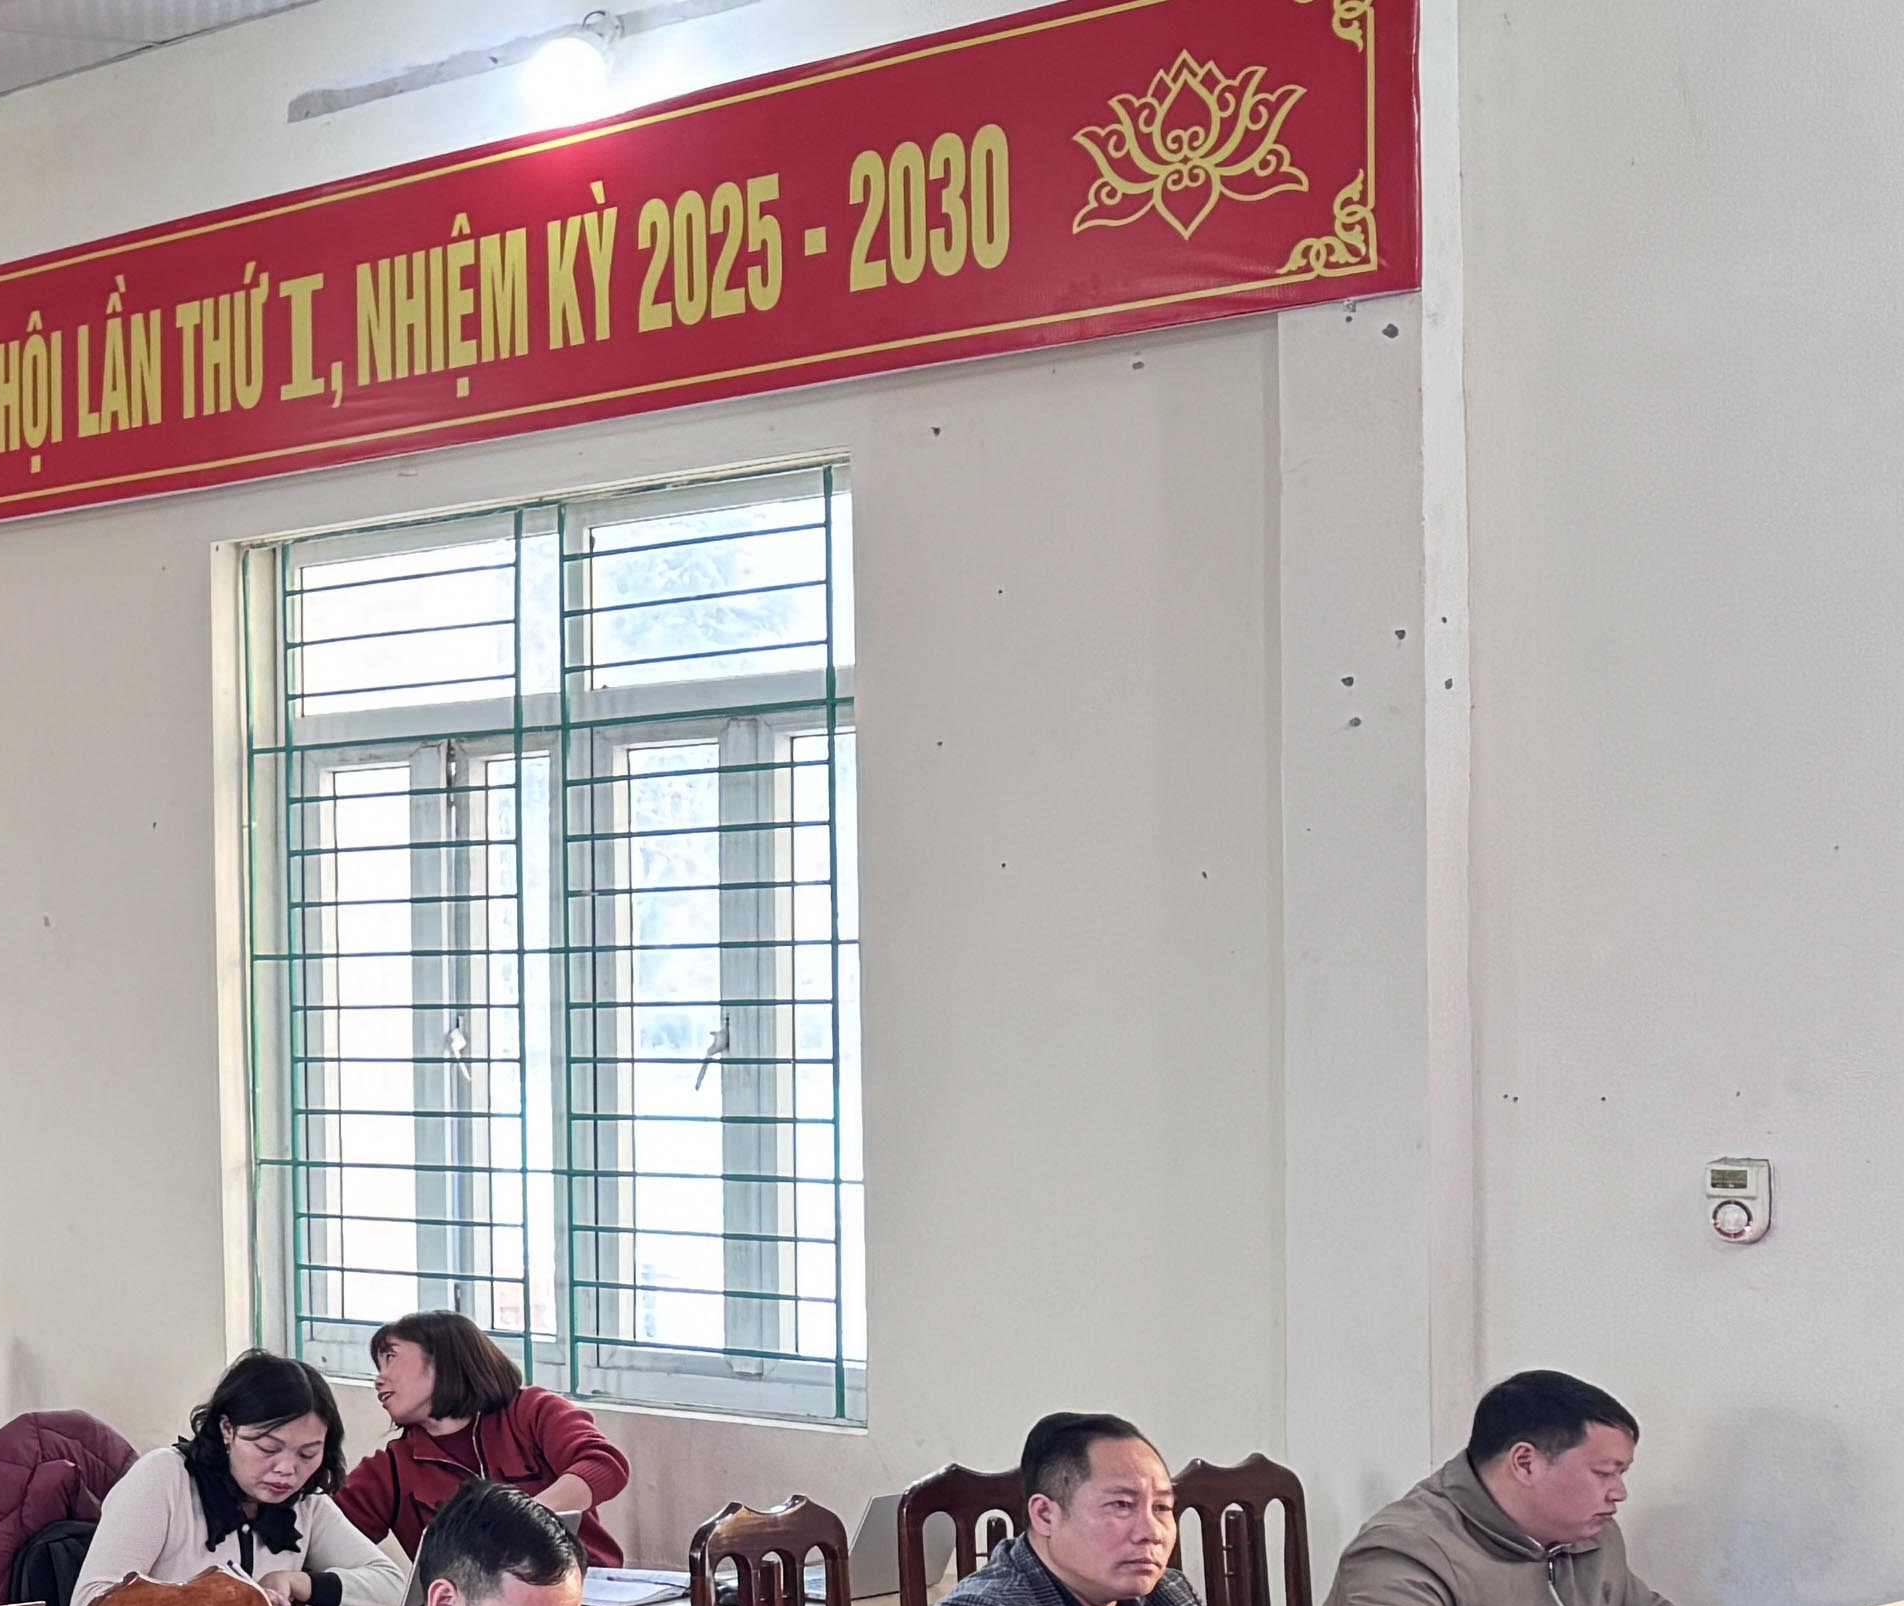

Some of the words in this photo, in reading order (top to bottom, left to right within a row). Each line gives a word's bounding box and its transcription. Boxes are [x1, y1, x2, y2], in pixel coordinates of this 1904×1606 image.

[77, 274, 162, 438] LẦN
[175, 260, 269, 419] THỨ
[279, 272, 344, 408] I,
[355, 211, 528, 399] NHIỆM
[547, 180, 618, 350] KỲ
[637, 173, 783, 334] 2025
[804, 226, 827, 256] -
[849, 123, 1010, 293] 2030
